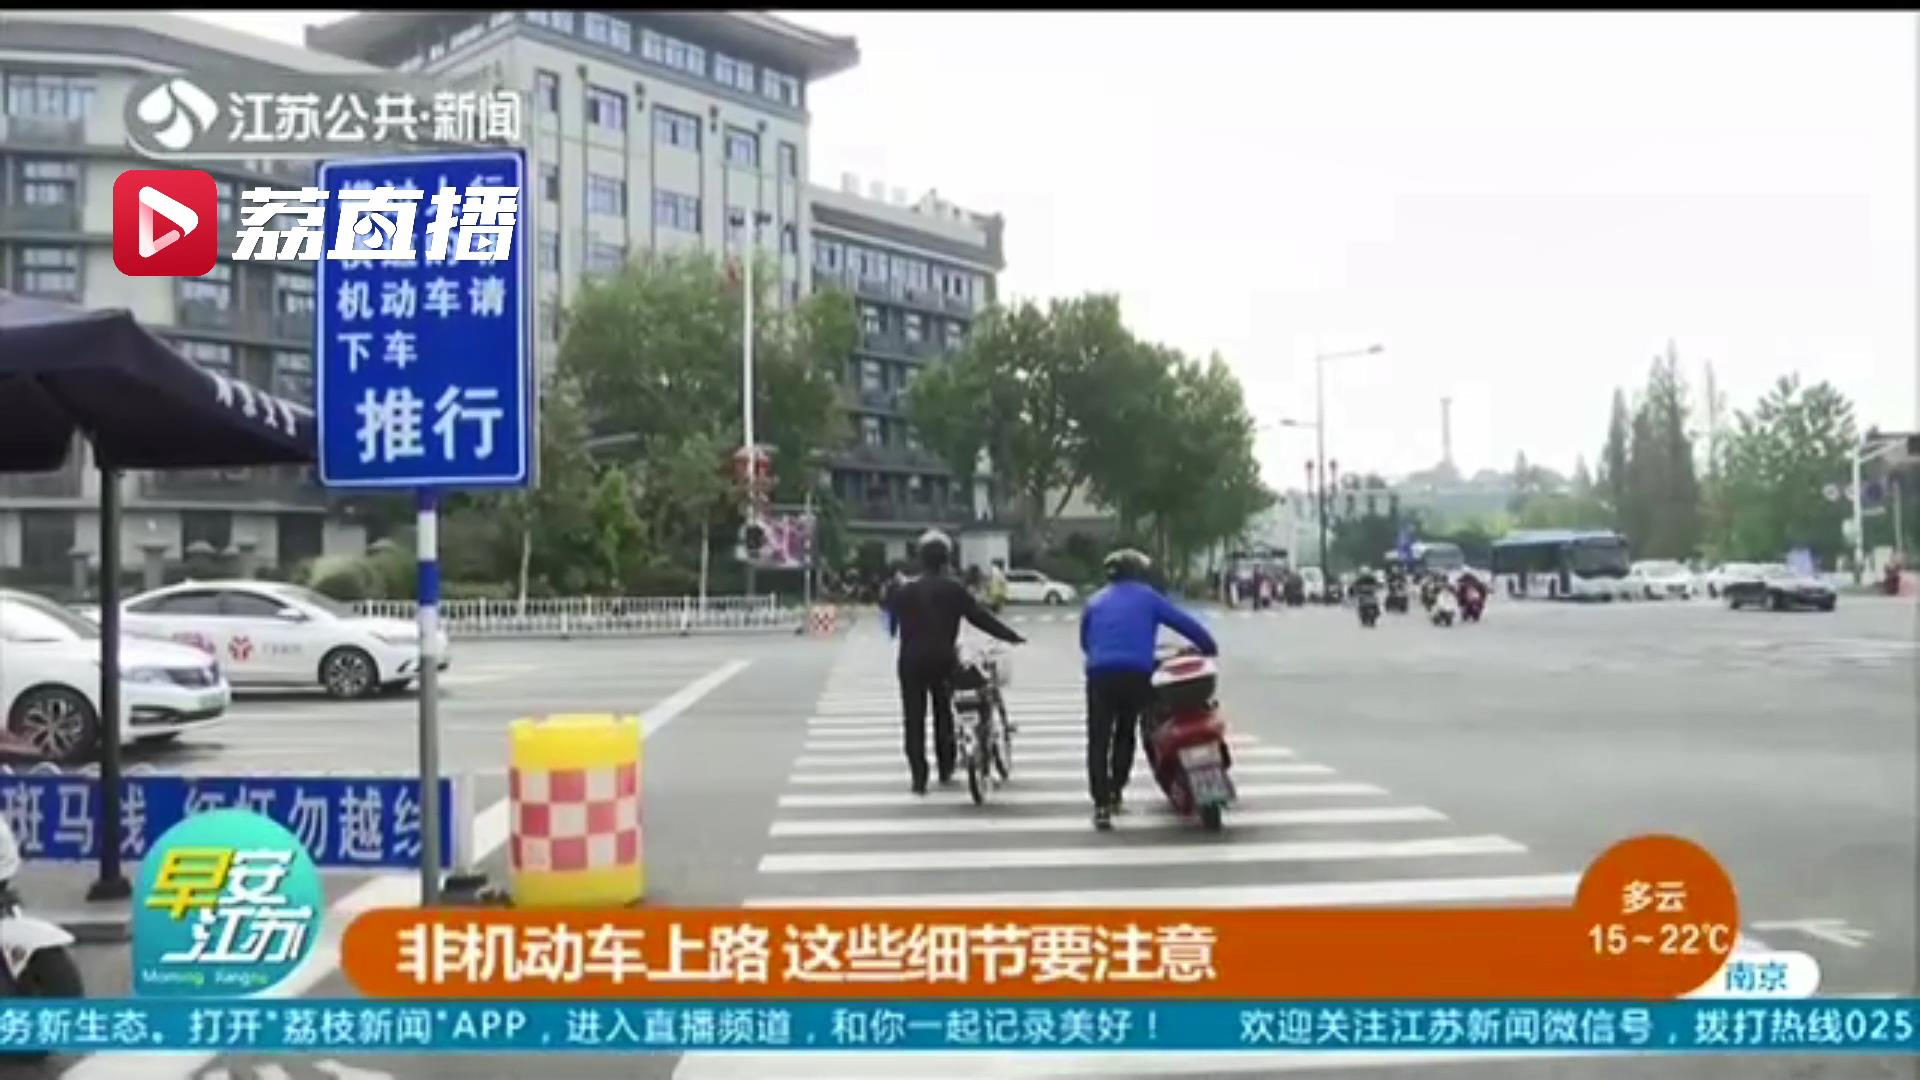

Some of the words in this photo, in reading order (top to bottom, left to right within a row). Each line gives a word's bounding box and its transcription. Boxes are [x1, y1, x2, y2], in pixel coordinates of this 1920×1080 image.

[335, 276, 507, 321] 机动车请
[336, 329, 419, 374] 下车
[354, 383, 505, 463] 推行
